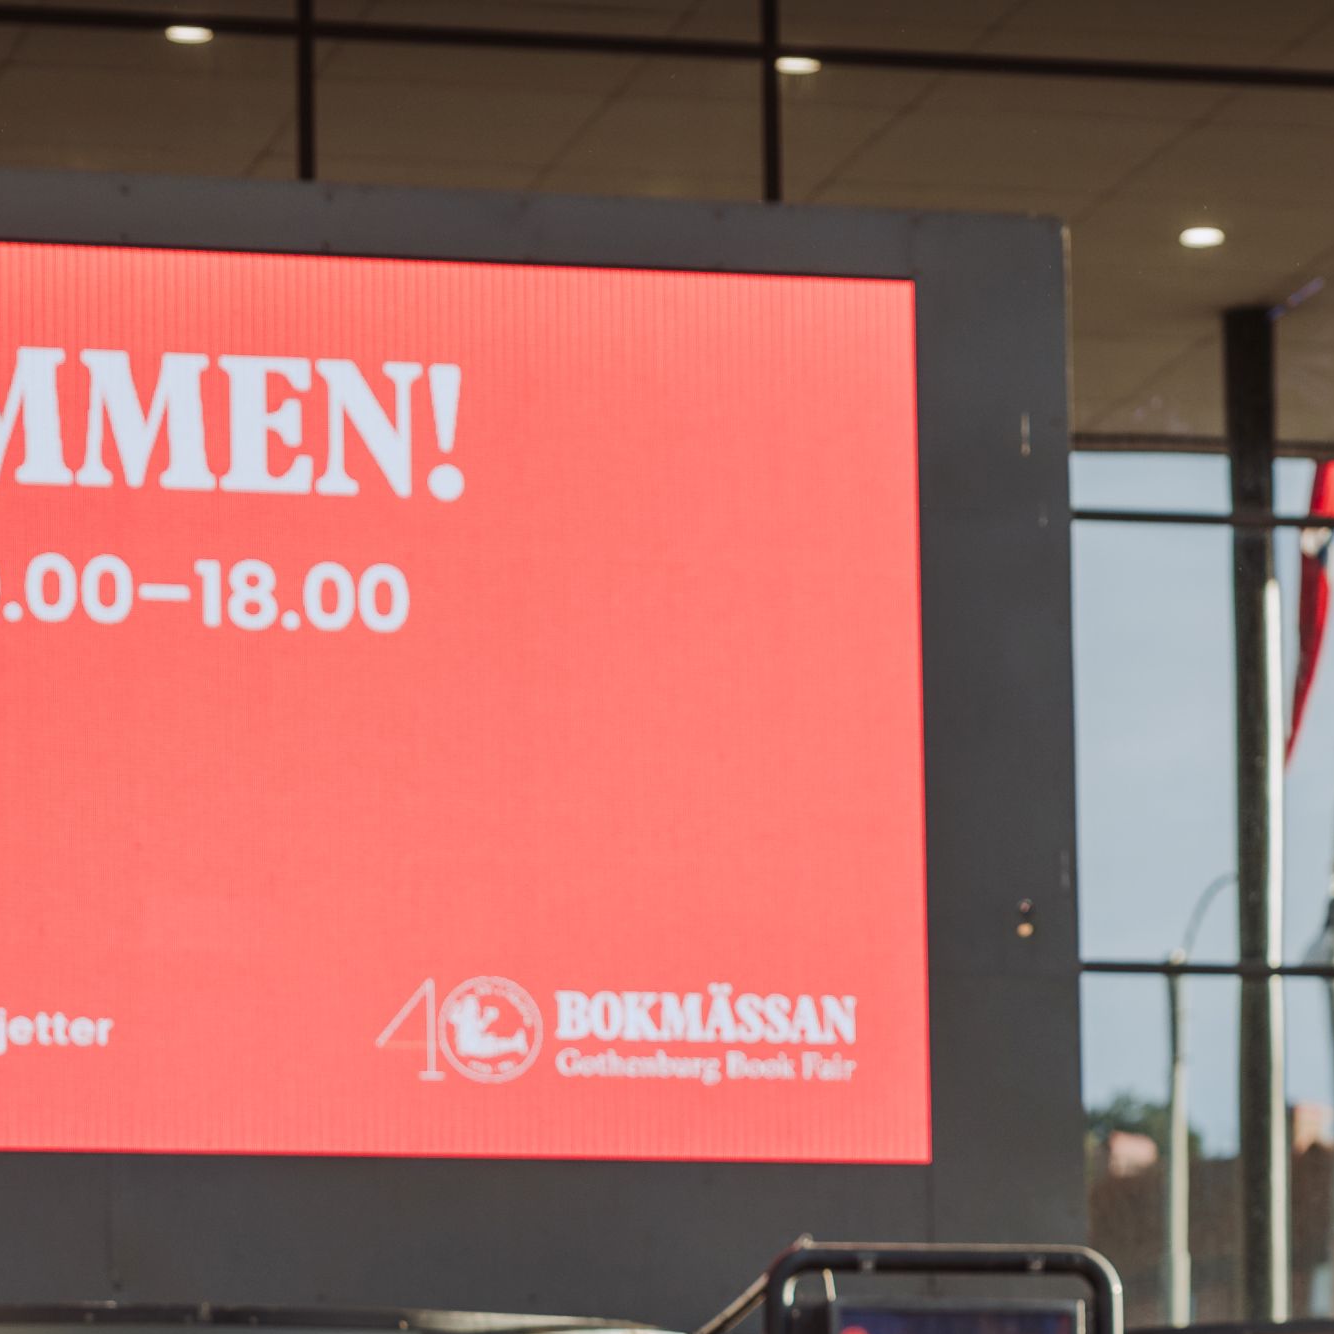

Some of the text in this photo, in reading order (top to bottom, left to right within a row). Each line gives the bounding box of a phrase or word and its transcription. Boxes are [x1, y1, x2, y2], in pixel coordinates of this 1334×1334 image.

[554, 982, 857, 1045] BOKMÄSSAN
[555, 1047, 857, 1086] Gothenburg Book Fair
